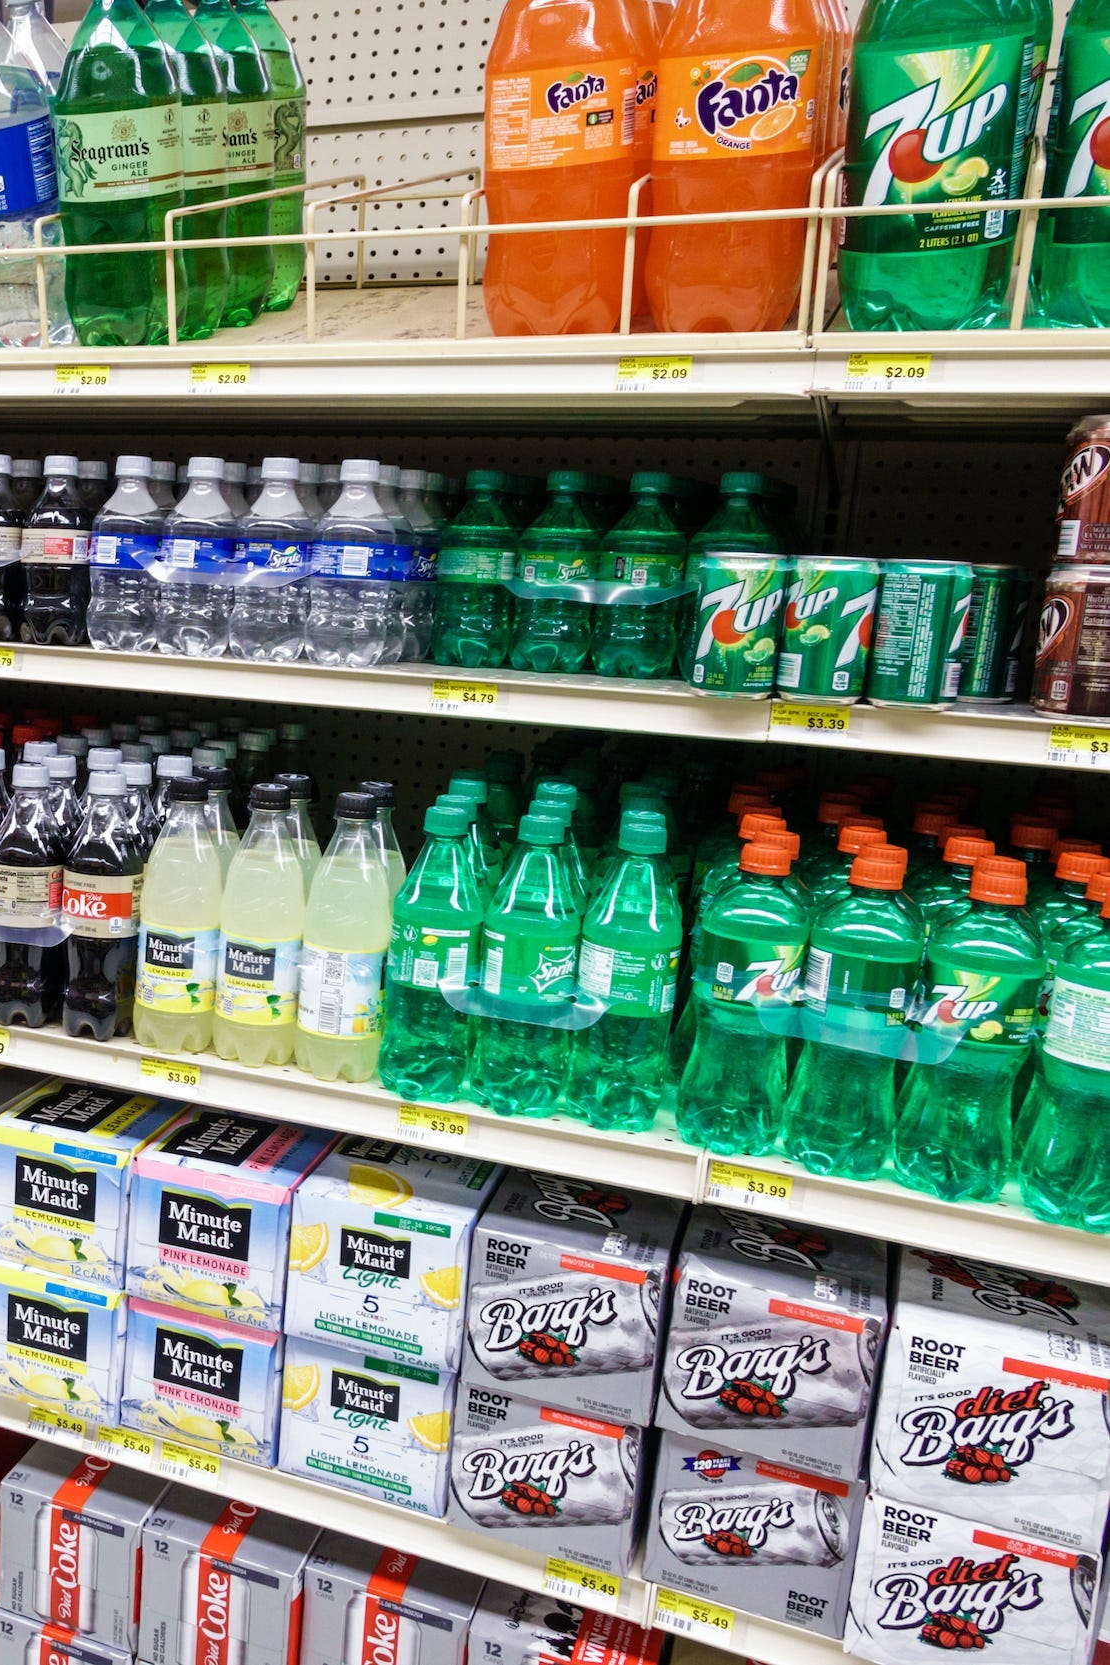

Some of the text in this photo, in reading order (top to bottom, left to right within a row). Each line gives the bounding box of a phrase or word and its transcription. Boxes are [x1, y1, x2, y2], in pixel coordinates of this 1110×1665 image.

[547, 74, 605, 113] Fanta
[696, 69, 799, 135] Fanta
[71, 137, 151, 164] Seagram's
[716, 136, 752, 150] ORANGE
[111, 161, 148, 172] GINGER
[242, 156, 256, 164] ALE
[131, 168, 148, 178] ALE
[924, 221, 980, 232] CAFFEINE FREE
[919, 239, 925, 248] 2
[926, 236, 950, 247] LITERS
[81, 376, 107, 385] $2.09
[218, 374, 246, 385] $2.09
[652, 369, 687, 379] $2.09
[886, 367, 925, 378] $2.09
[463, 693, 494, 704] $4.79
[808, 718, 845, 730] $3.39
[1052, 731, 1072, 739] ROOT
[148, 937, 190, 953] Minute
[152, 949, 184, 964] Maid
[148, 968, 185, 978] LEMONADE
[718, 963, 733, 974] 200
[228, 978, 266, 989] LEMONADE
[168, 1072, 197, 1085] $3.99
[400, 1110, 451, 1122] SPRITE BOTTLES
[431, 1121, 464, 1135] $3.99
[22, 1164, 89, 1195] Minute
[30, 1186, 82, 1212] Maid
[748, 1181, 787, 1198] $3.99
[168, 1201, 242, 1232] Minute
[177, 1224, 234, 1250] Maid
[347, 1235, 405, 1258] Minute
[488, 1238, 531, 1257] ROOT
[163, 1248, 247, 1276] PINK LEMONADE
[354, 1251, 395, 1271] Maid
[486, 1253, 526, 1270] BEER
[343, 1264, 401, 1289] Light
[688, 1279, 737, 1300] ROOT
[363, 1295, 379, 1313] 5
[686, 1294, 731, 1315] BEER
[14, 1302, 81, 1335] Minute
[480, 1288, 618, 1352] Barq's
[685, 1307, 717, 1321] ARTIFICIALLY
[319, 1310, 419, 1343] LIGHT LEMONADE
[721, 1328, 772, 1341] IT'S GOOD
[22, 1323, 74, 1350] Maid
[163, 1338, 234, 1373] Minute
[910, 1336, 966, 1359] ROOT
[678, 1336, 831, 1399] Barq's
[909, 1351, 960, 1374] BEER
[171, 1361, 225, 1389] Maid
[907, 1373, 937, 1385] FLAVORED
[908, 1365, 946, 1380] ARTIFICIALLY
[338, 1377, 394, 1403] Minute
[470, 1389, 512, 1407] ROOT
[915, 1389, 972, 1402] IT'S GOOD
[956, 1381, 1048, 1418] diet
[158, 1385, 239, 1416] PINK LEMONADE
[345, 1393, 385, 1414] Maid
[333, 1405, 391, 1432] Light
[468, 1402, 507, 1421] BEER
[56, 1417, 83, 1433] $5.49
[900, 1397, 1076, 1466] Barq's
[123, 1438, 150, 1454] $5.49
[353, 1435, 369, 1454] 5
[188, 1458, 217, 1474] $5.49
[310, 1449, 342, 1464] LIGHT
[346, 1459, 408, 1484] LEMONADE
[462, 1441, 597, 1500] Barq's
[692, 1459, 711, 1471] 120
[10, 1491, 24, 1506] 12
[383, 1491, 428, 1511] 12 CANS
[674, 1498, 795, 1549] Barq's
[883, 1505, 938, 1528] ROOT
[882, 1520, 931, 1543] BEER
[882, 1534, 918, 1547] ARTIFICIALLY
[880, 1541, 909, 1553] FLAVORED
[50, 1522, 78, 1619] Diet Coke
[887, 1558, 943, 1569] IT'S GOOD
[927, 1554, 1019, 1586] diet
[317, 1579, 332, 1593] 12
[581, 1576, 616, 1595] $5.49
[197, 1572, 229, 1640] Coke
[788, 1590, 828, 1608] ROOT
[874, 1570, 1045, 1632] Barq's
[787, 1600, 824, 1619] BEER
[692, 1610, 729, 1629] $5.49
